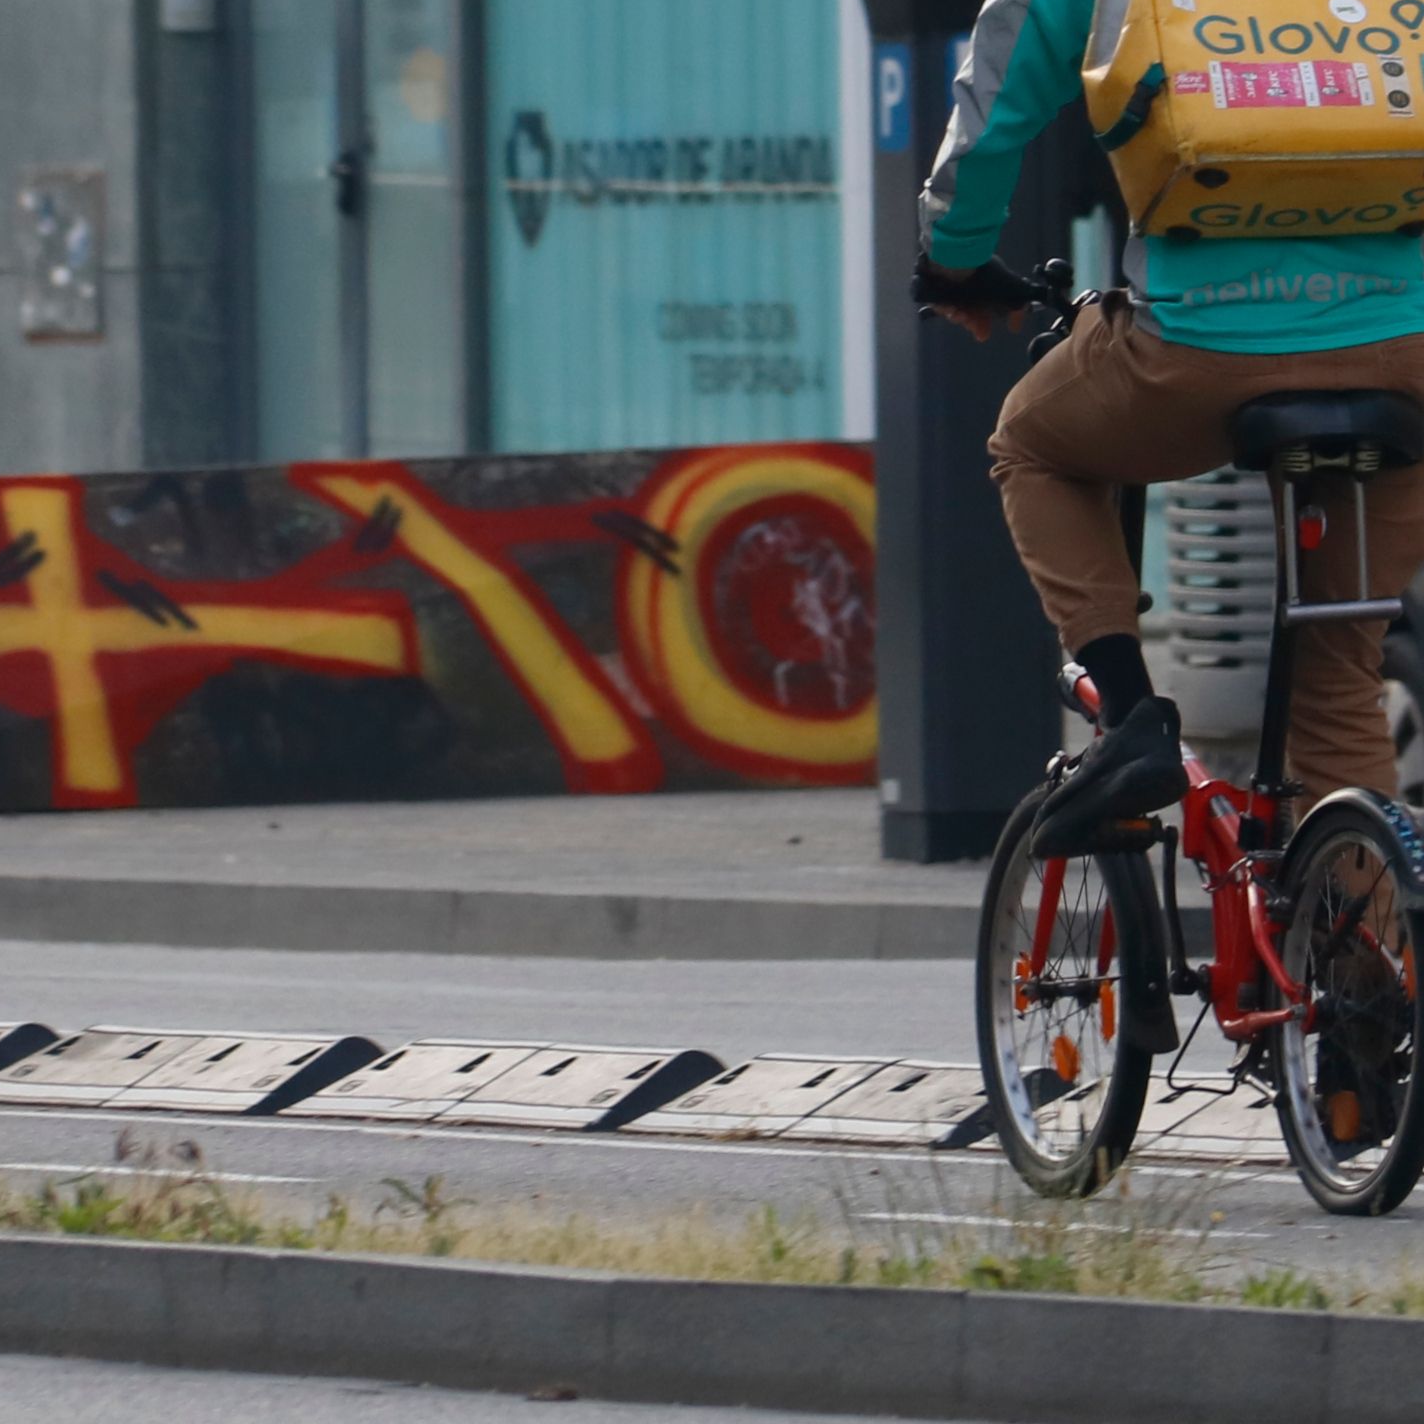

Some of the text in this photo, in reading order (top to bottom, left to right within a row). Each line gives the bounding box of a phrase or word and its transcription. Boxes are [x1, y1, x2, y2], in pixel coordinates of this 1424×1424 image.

[1193, 14, 1401, 55] Glovo
[880, 58, 905, 138] P
[1189, 202, 1398, 228] Glovo
